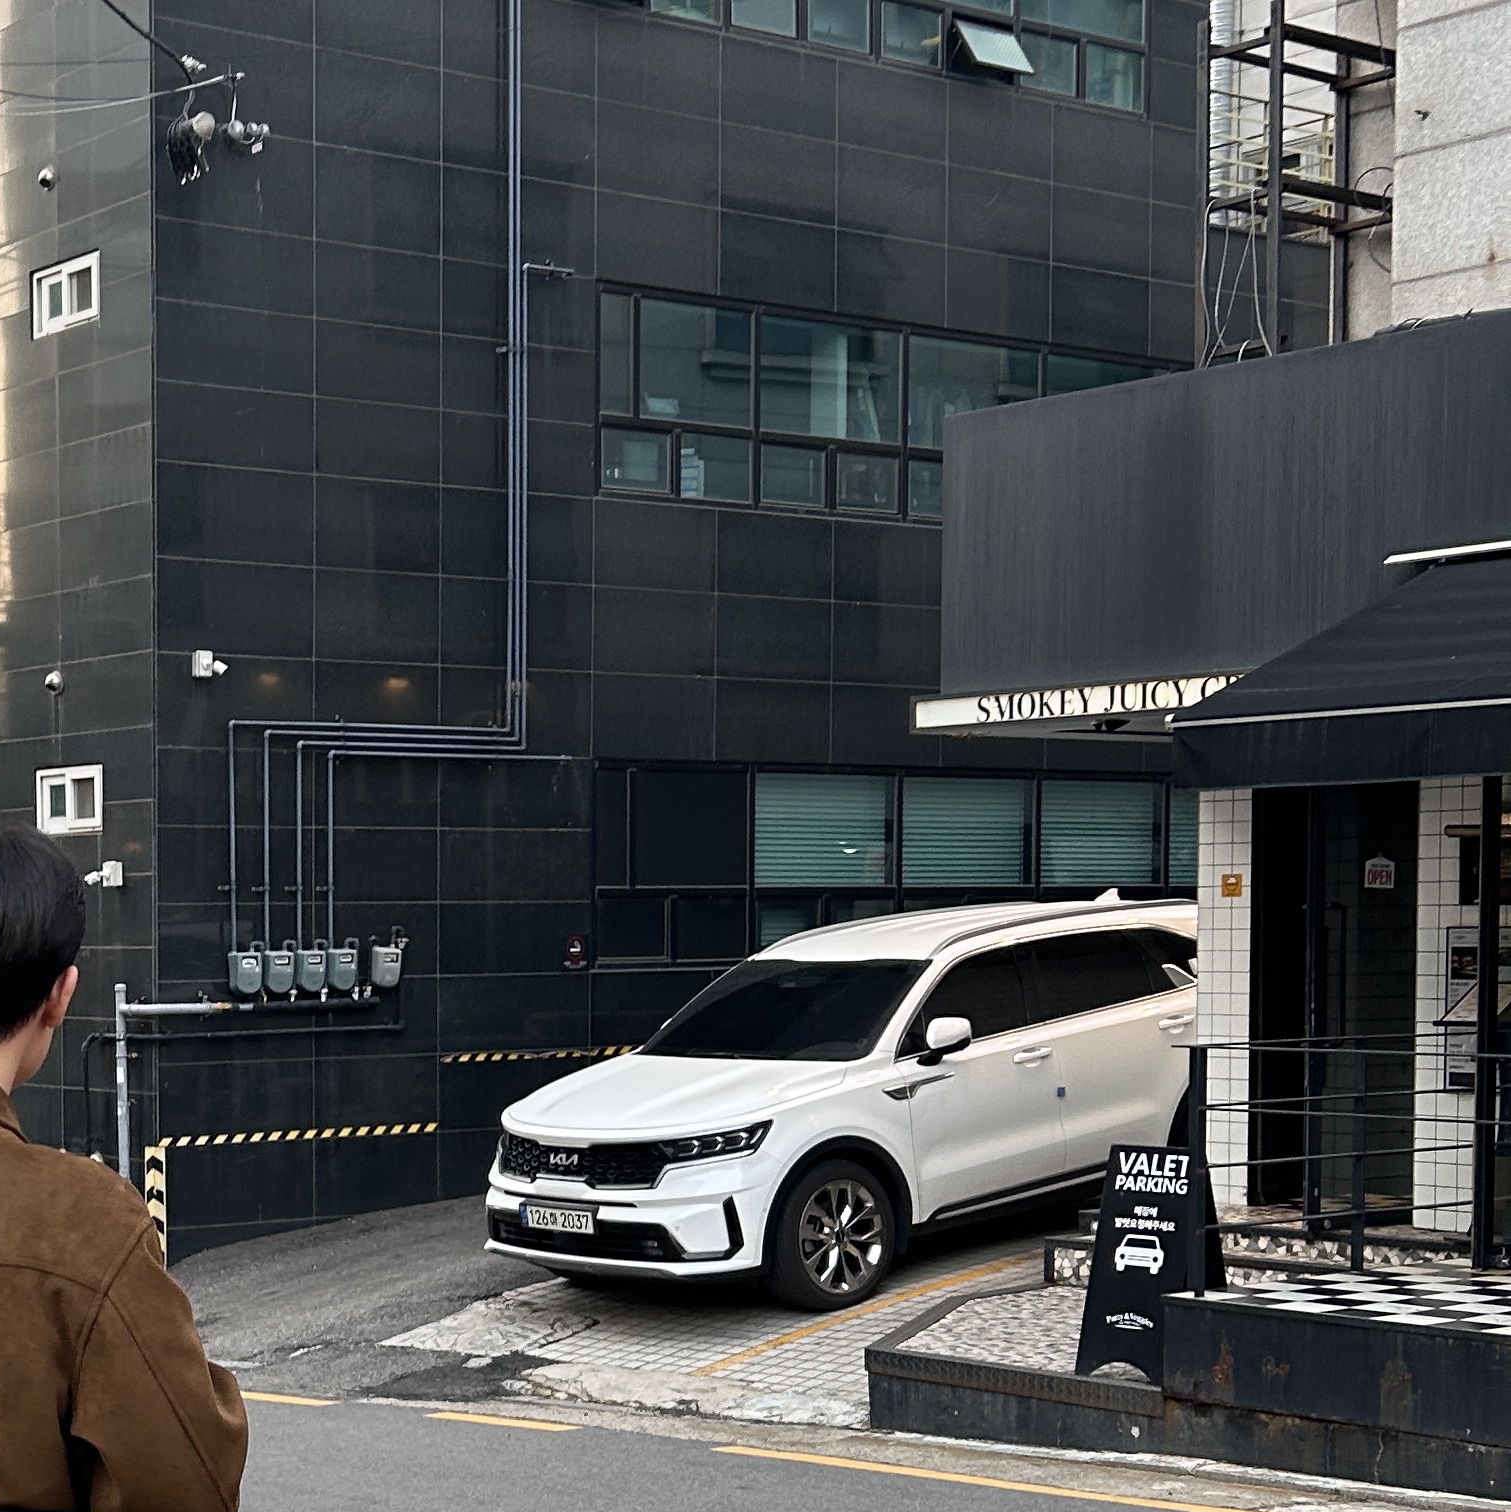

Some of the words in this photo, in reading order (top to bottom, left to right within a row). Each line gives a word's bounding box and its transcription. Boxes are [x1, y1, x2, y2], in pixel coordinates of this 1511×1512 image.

[976, 686, 1095, 724] SMOKEY
[1103, 680, 1190, 713] JUICY
[1368, 868, 1393, 886] OPEN
[1119, 1151, 1189, 1177] VALET
[1114, 1174, 1189, 1195] PARKING
[559, 1211, 589, 1231] 2037
